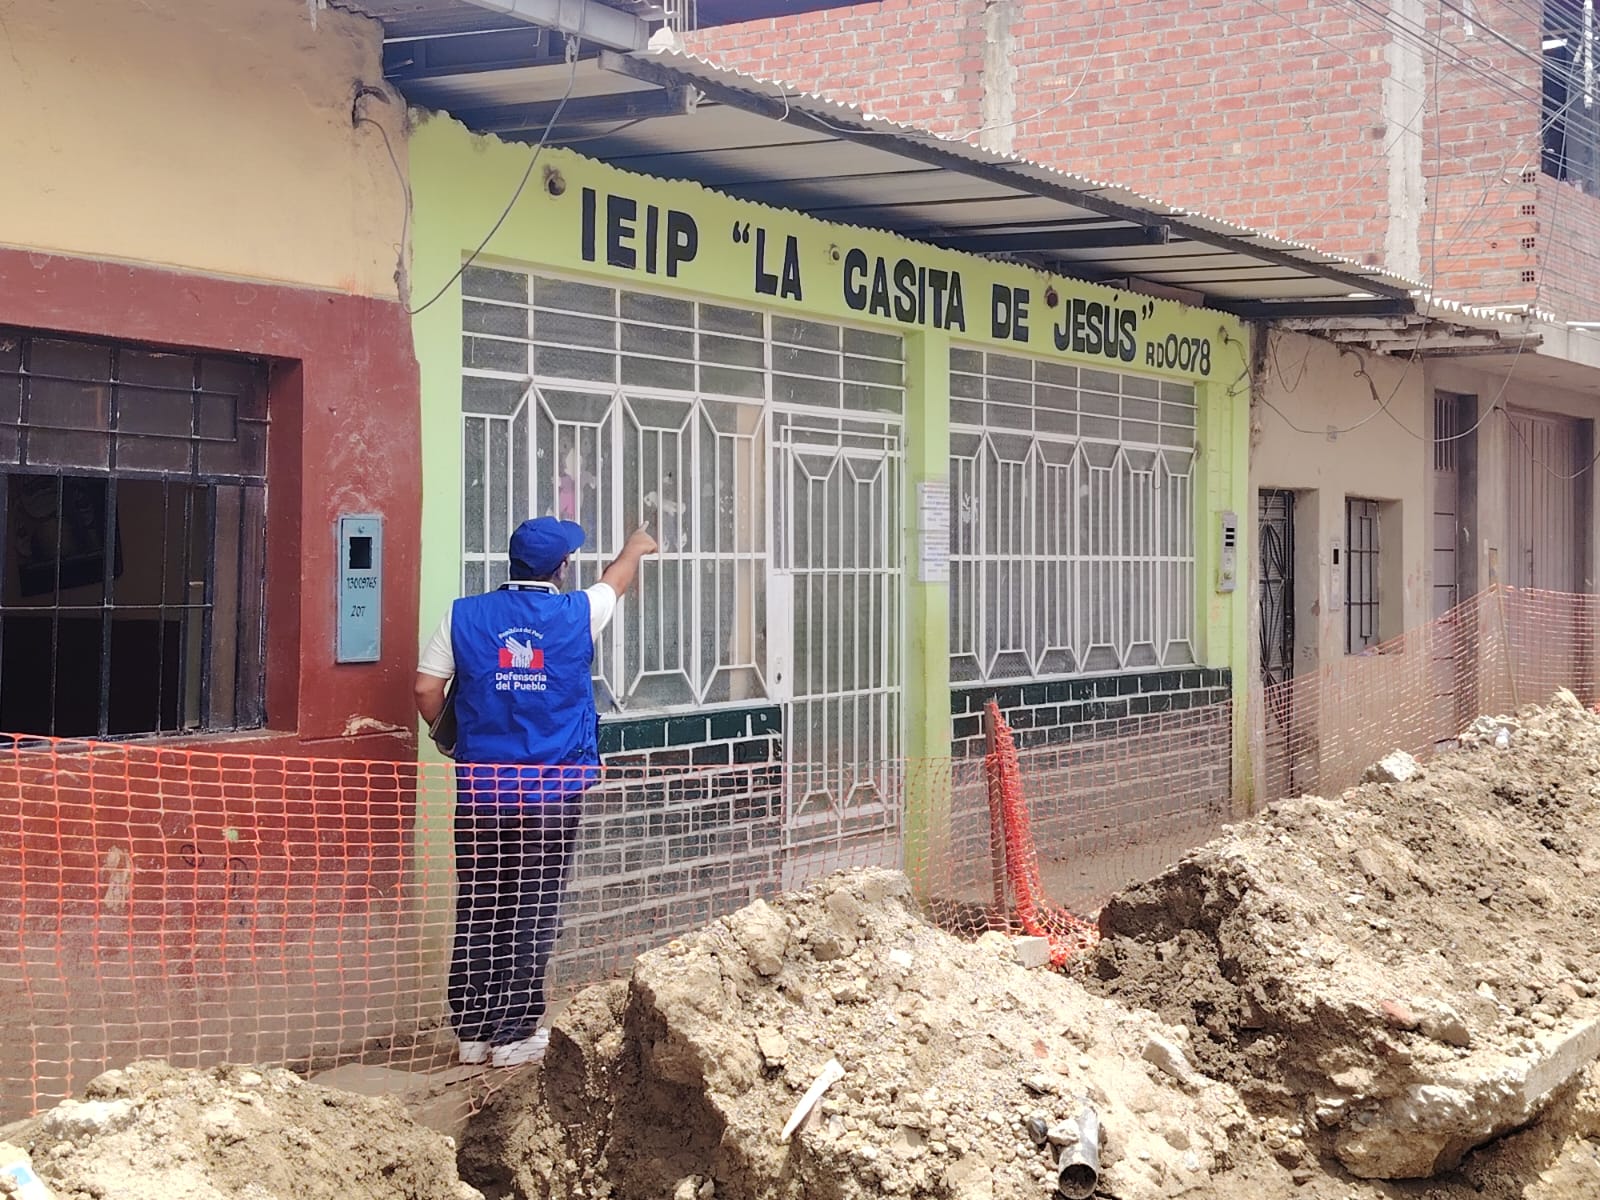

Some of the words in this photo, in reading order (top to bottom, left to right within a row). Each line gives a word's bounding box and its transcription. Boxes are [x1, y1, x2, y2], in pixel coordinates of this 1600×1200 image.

[581, 187, 699, 277] IEIP
[843, 248, 966, 332] CASITA
[991, 284, 1030, 342] DE
[350, 605, 366, 617] 207
[495, 672, 547, 681] Defensoría
[495, 681, 511, 691] del
[513, 681, 547, 691] Pueblo
